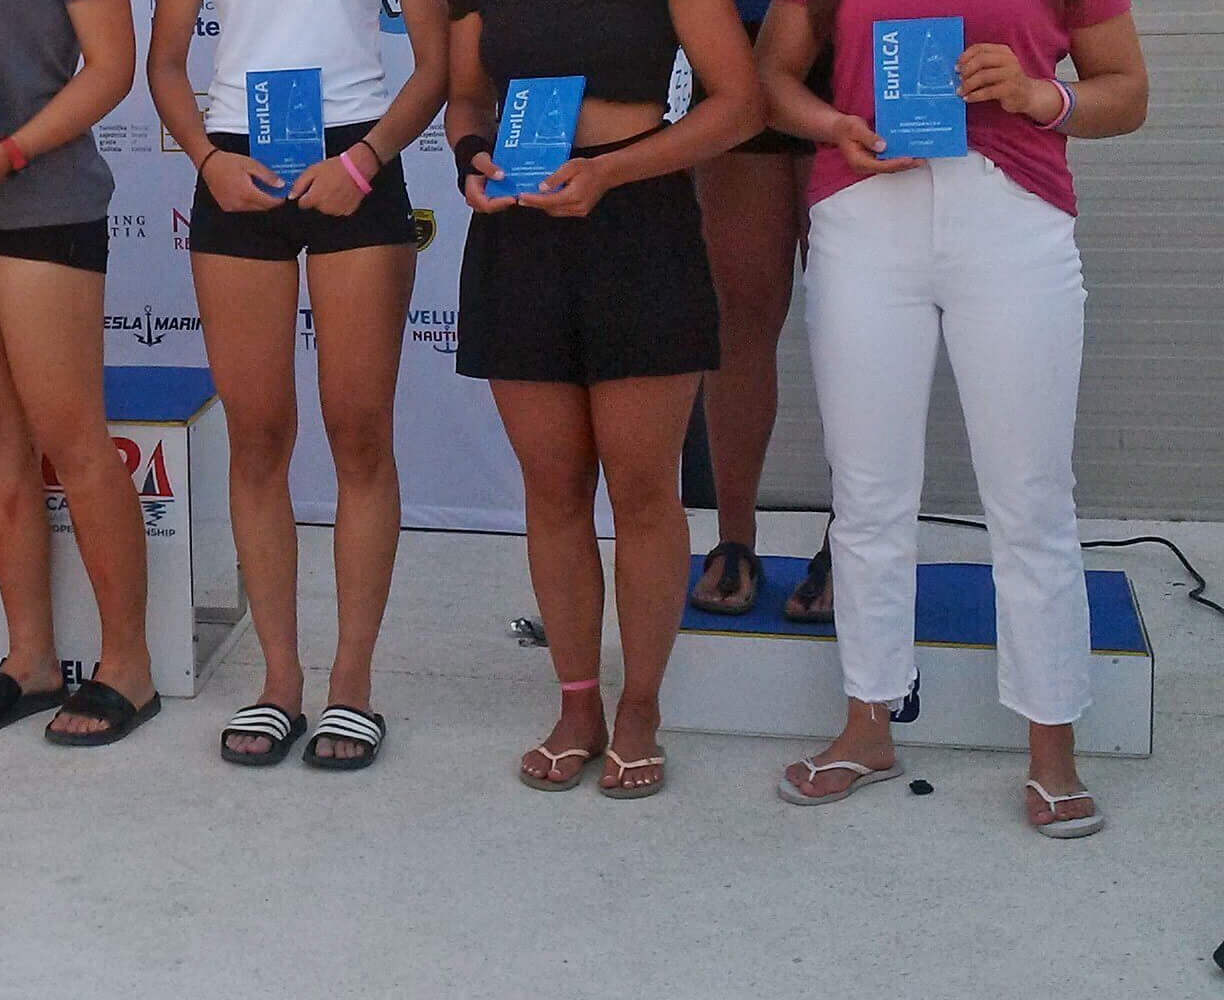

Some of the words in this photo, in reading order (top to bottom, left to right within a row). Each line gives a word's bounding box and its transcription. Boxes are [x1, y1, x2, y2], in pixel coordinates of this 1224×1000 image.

[882, 31, 900, 100] EurILCA
[257, 80, 271, 145] EurILCA
[504, 89, 530, 148] EurILCA
[103, 316, 142, 330] ESLA
[154, 317, 201, 331] MARI
[408, 310, 455, 325] VELU
[413, 331, 456, 342] NAUTI
